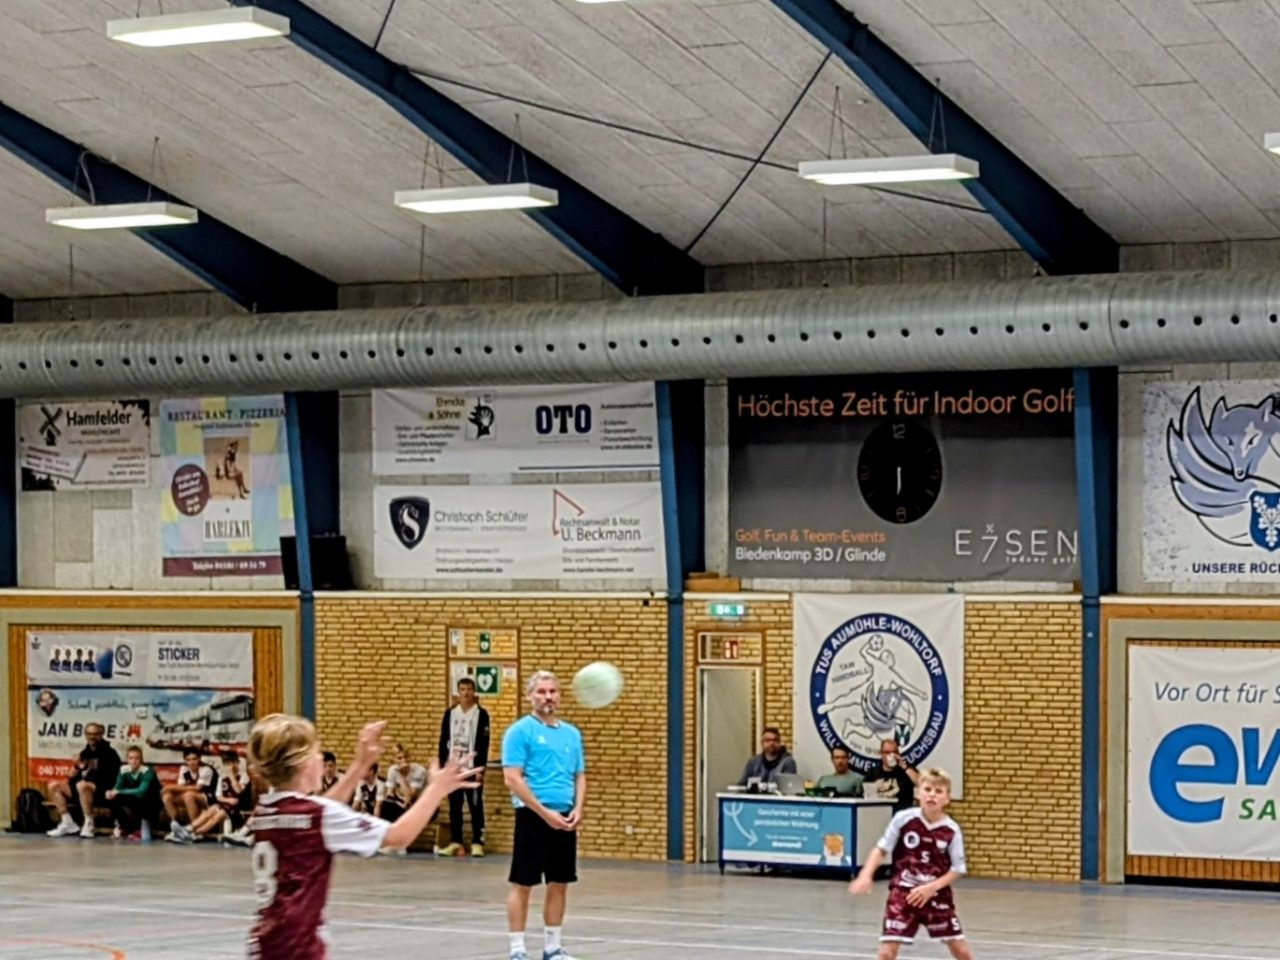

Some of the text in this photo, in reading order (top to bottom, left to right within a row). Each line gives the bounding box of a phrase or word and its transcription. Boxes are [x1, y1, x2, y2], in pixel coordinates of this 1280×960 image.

[738, 386, 1076, 417] Höchste Zeit für Indoor Golf
[66, 408, 132, 427] Hamfelder
[167, 410, 233, 423] RESTAURANT
[535, 403, 592, 435] OTO
[434, 510, 484, 524] Christoph
[576, 527, 641, 541] Beckmann
[764, 528, 788, 542] Fun
[802, 528, 887, 543] Team-Events
[814, 547, 834, 561] 3D
[835, 547, 843, 563] /
[844, 547, 887, 562] Glinde
[1191, 562, 1246, 576] UNSERE
[158, 647, 200, 662] STICKER
[816, 616, 943, 677] TUS AUMÜHLE-WOHLTORF
[1154, 681, 1191, 702] Vor
[1195, 682, 1231, 704] Ort
[1235, 681, 1268, 706] für
[38, 723, 117, 739] JAN BE
